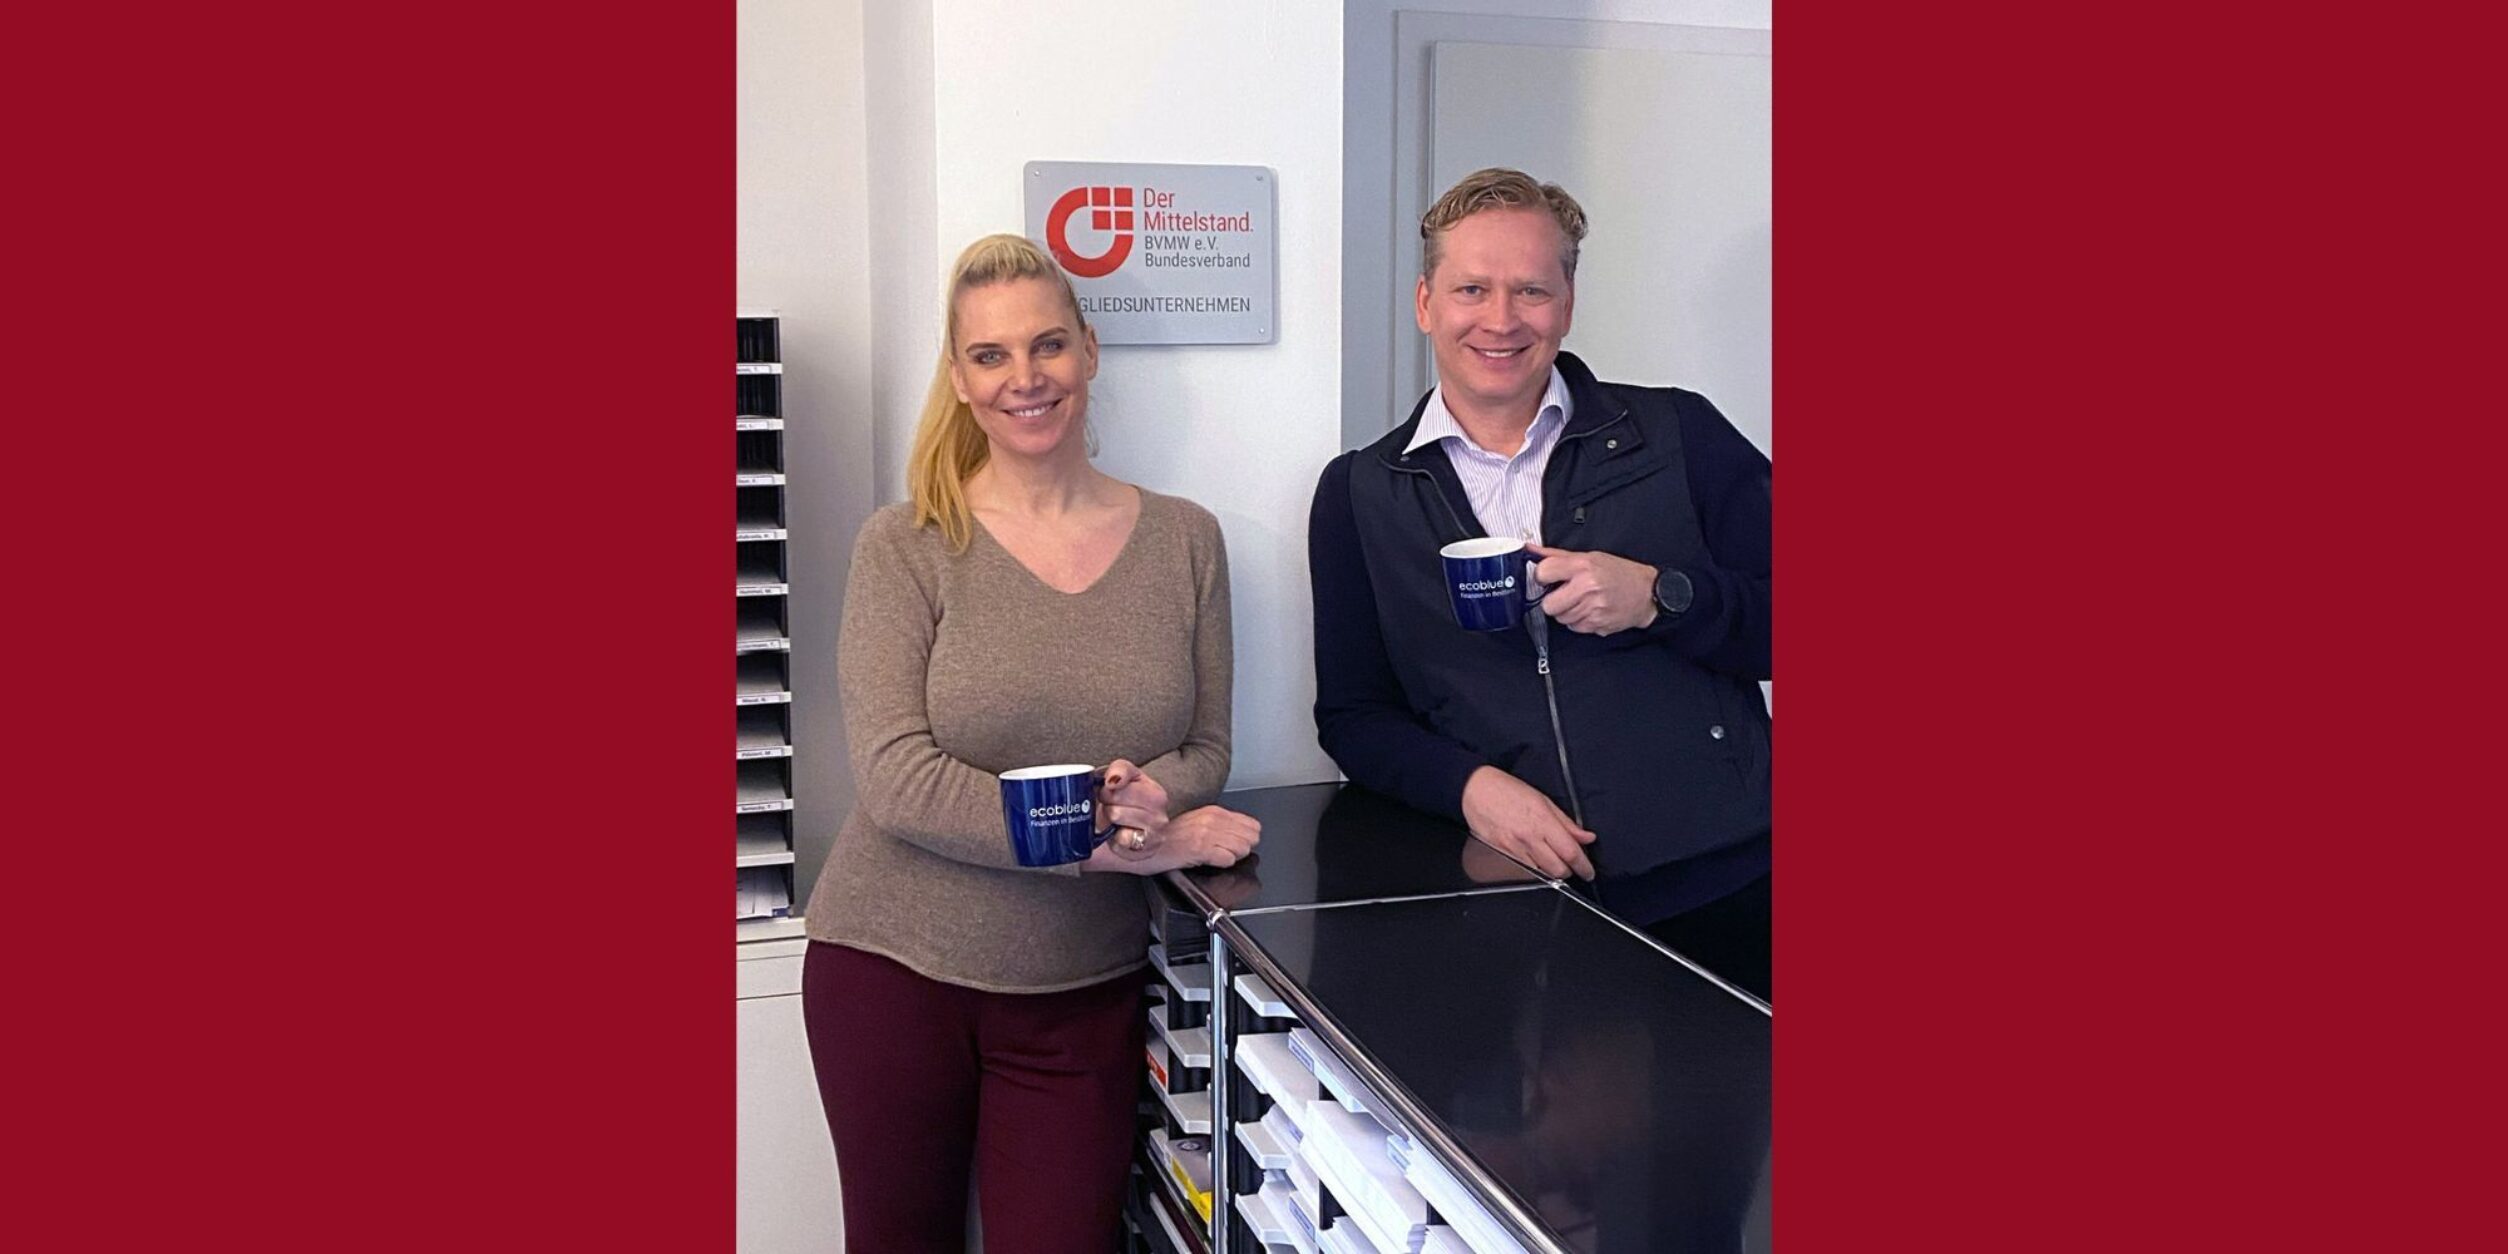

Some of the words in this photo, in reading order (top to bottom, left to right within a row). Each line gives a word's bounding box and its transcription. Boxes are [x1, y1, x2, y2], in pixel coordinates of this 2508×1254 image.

[1143, 187, 1175, 208] Der
[1143, 211, 1254, 232] Mittelstand.
[1144, 236, 1191, 250] BVMW
[1194, 236, 1219, 250] e.V.
[1145, 253, 1251, 268] Bundesverband
[1078, 297, 1251, 313] GLIEDSUNTERNEHMEN
[1459, 580, 1504, 591] ecoblue
[1029, 803, 1081, 818] ecoblue
